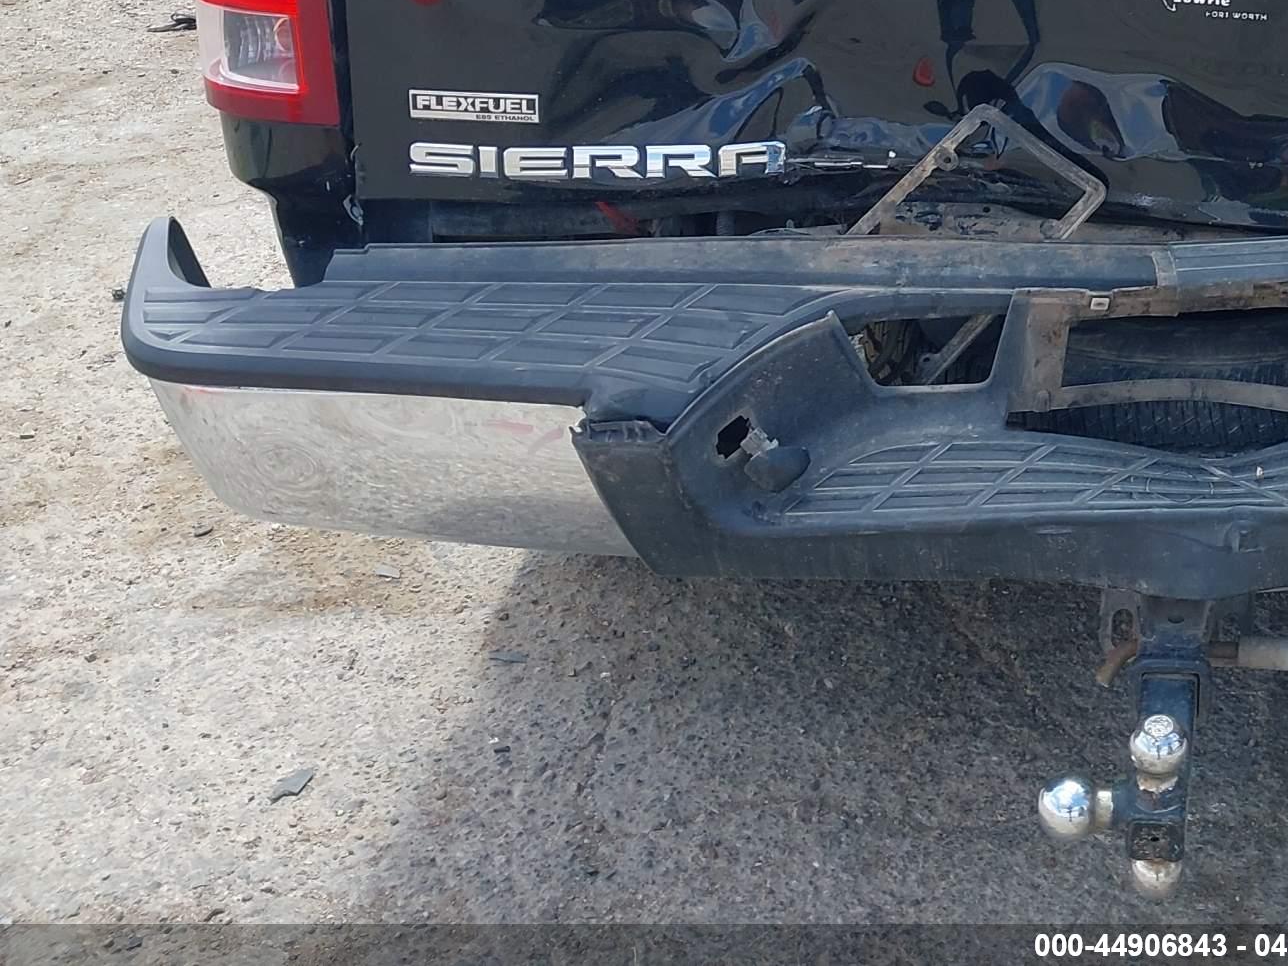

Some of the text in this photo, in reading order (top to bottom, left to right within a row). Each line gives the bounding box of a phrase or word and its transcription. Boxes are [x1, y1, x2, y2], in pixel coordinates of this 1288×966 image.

[1232, 12, 1268, 21] WORTH
[416, 95, 535, 114] FLEXFUEL
[494, 114, 535, 122] ETHANOL
[409, 141, 787, 180] SIERRA
